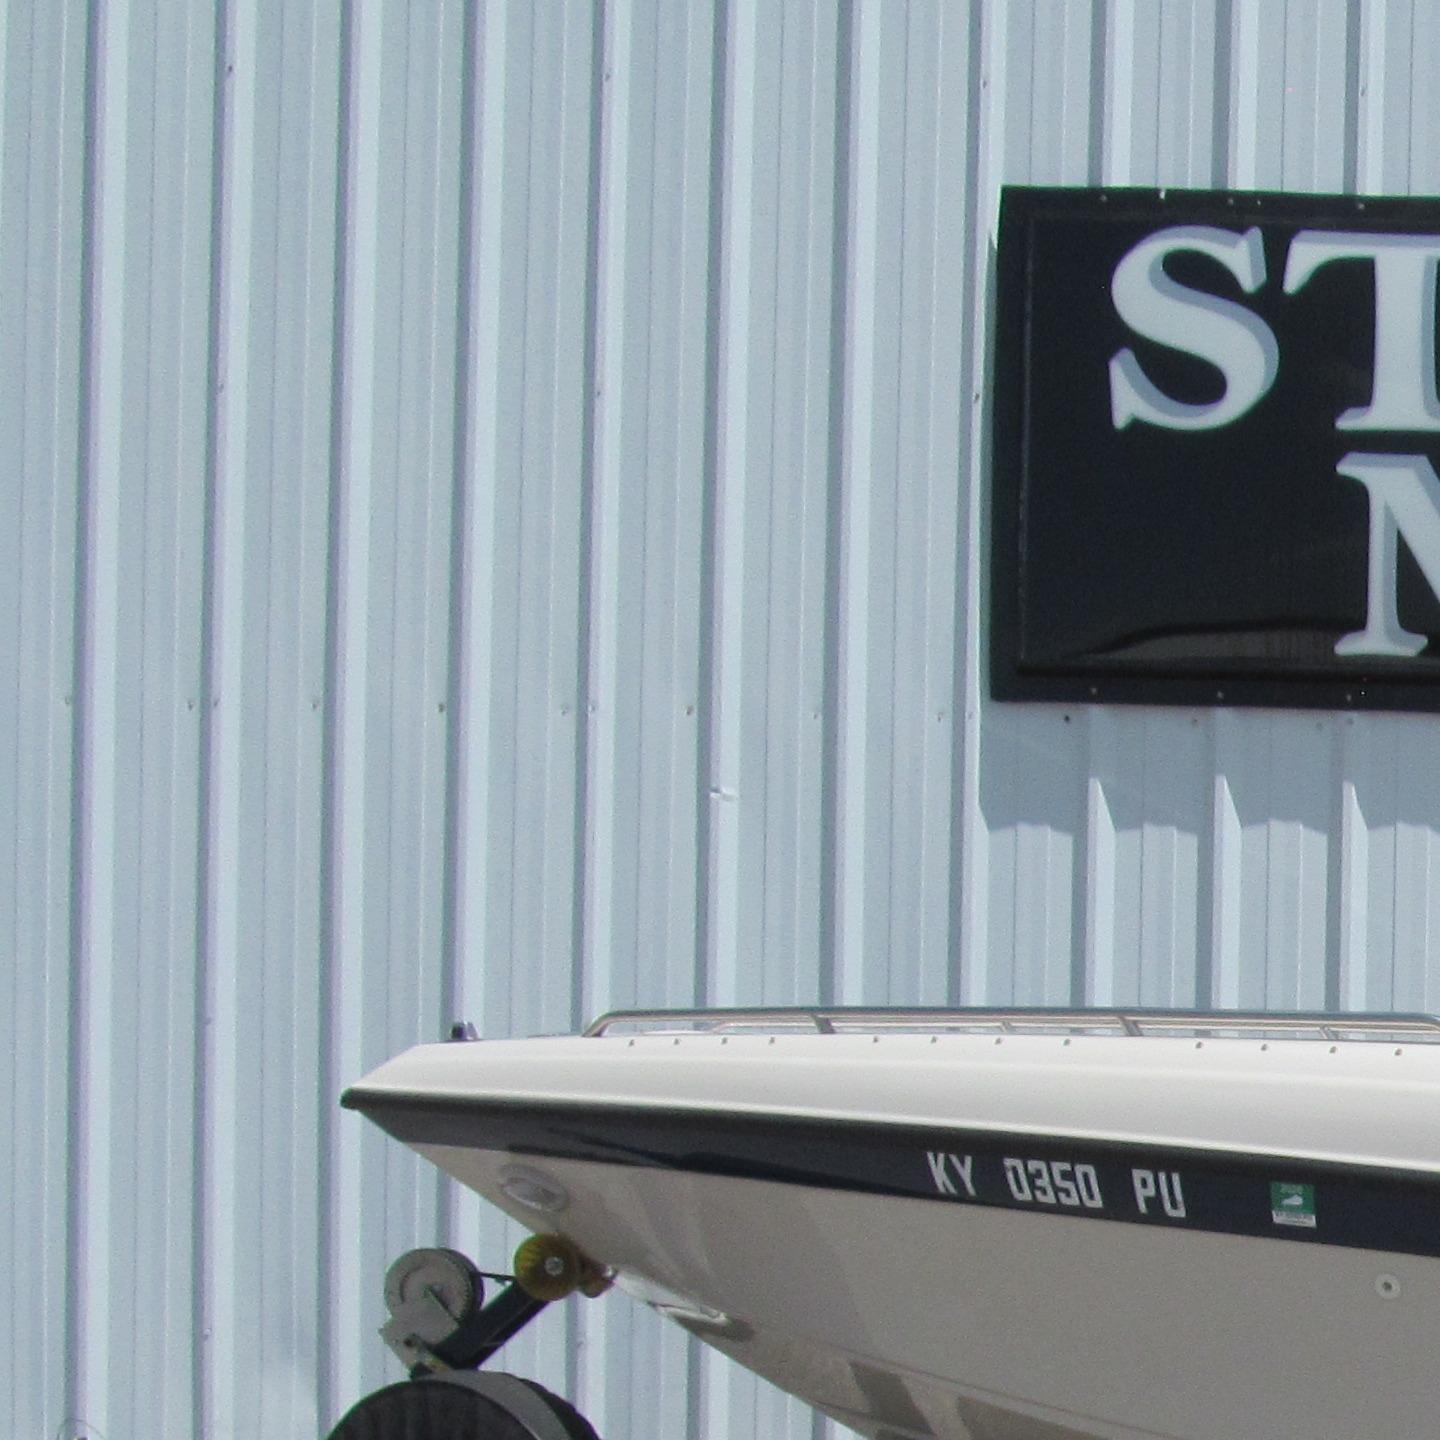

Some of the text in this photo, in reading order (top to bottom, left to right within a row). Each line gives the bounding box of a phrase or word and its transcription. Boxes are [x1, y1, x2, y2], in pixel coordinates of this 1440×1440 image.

[927, 1152, 1187, 1218] KY 0350 PU
